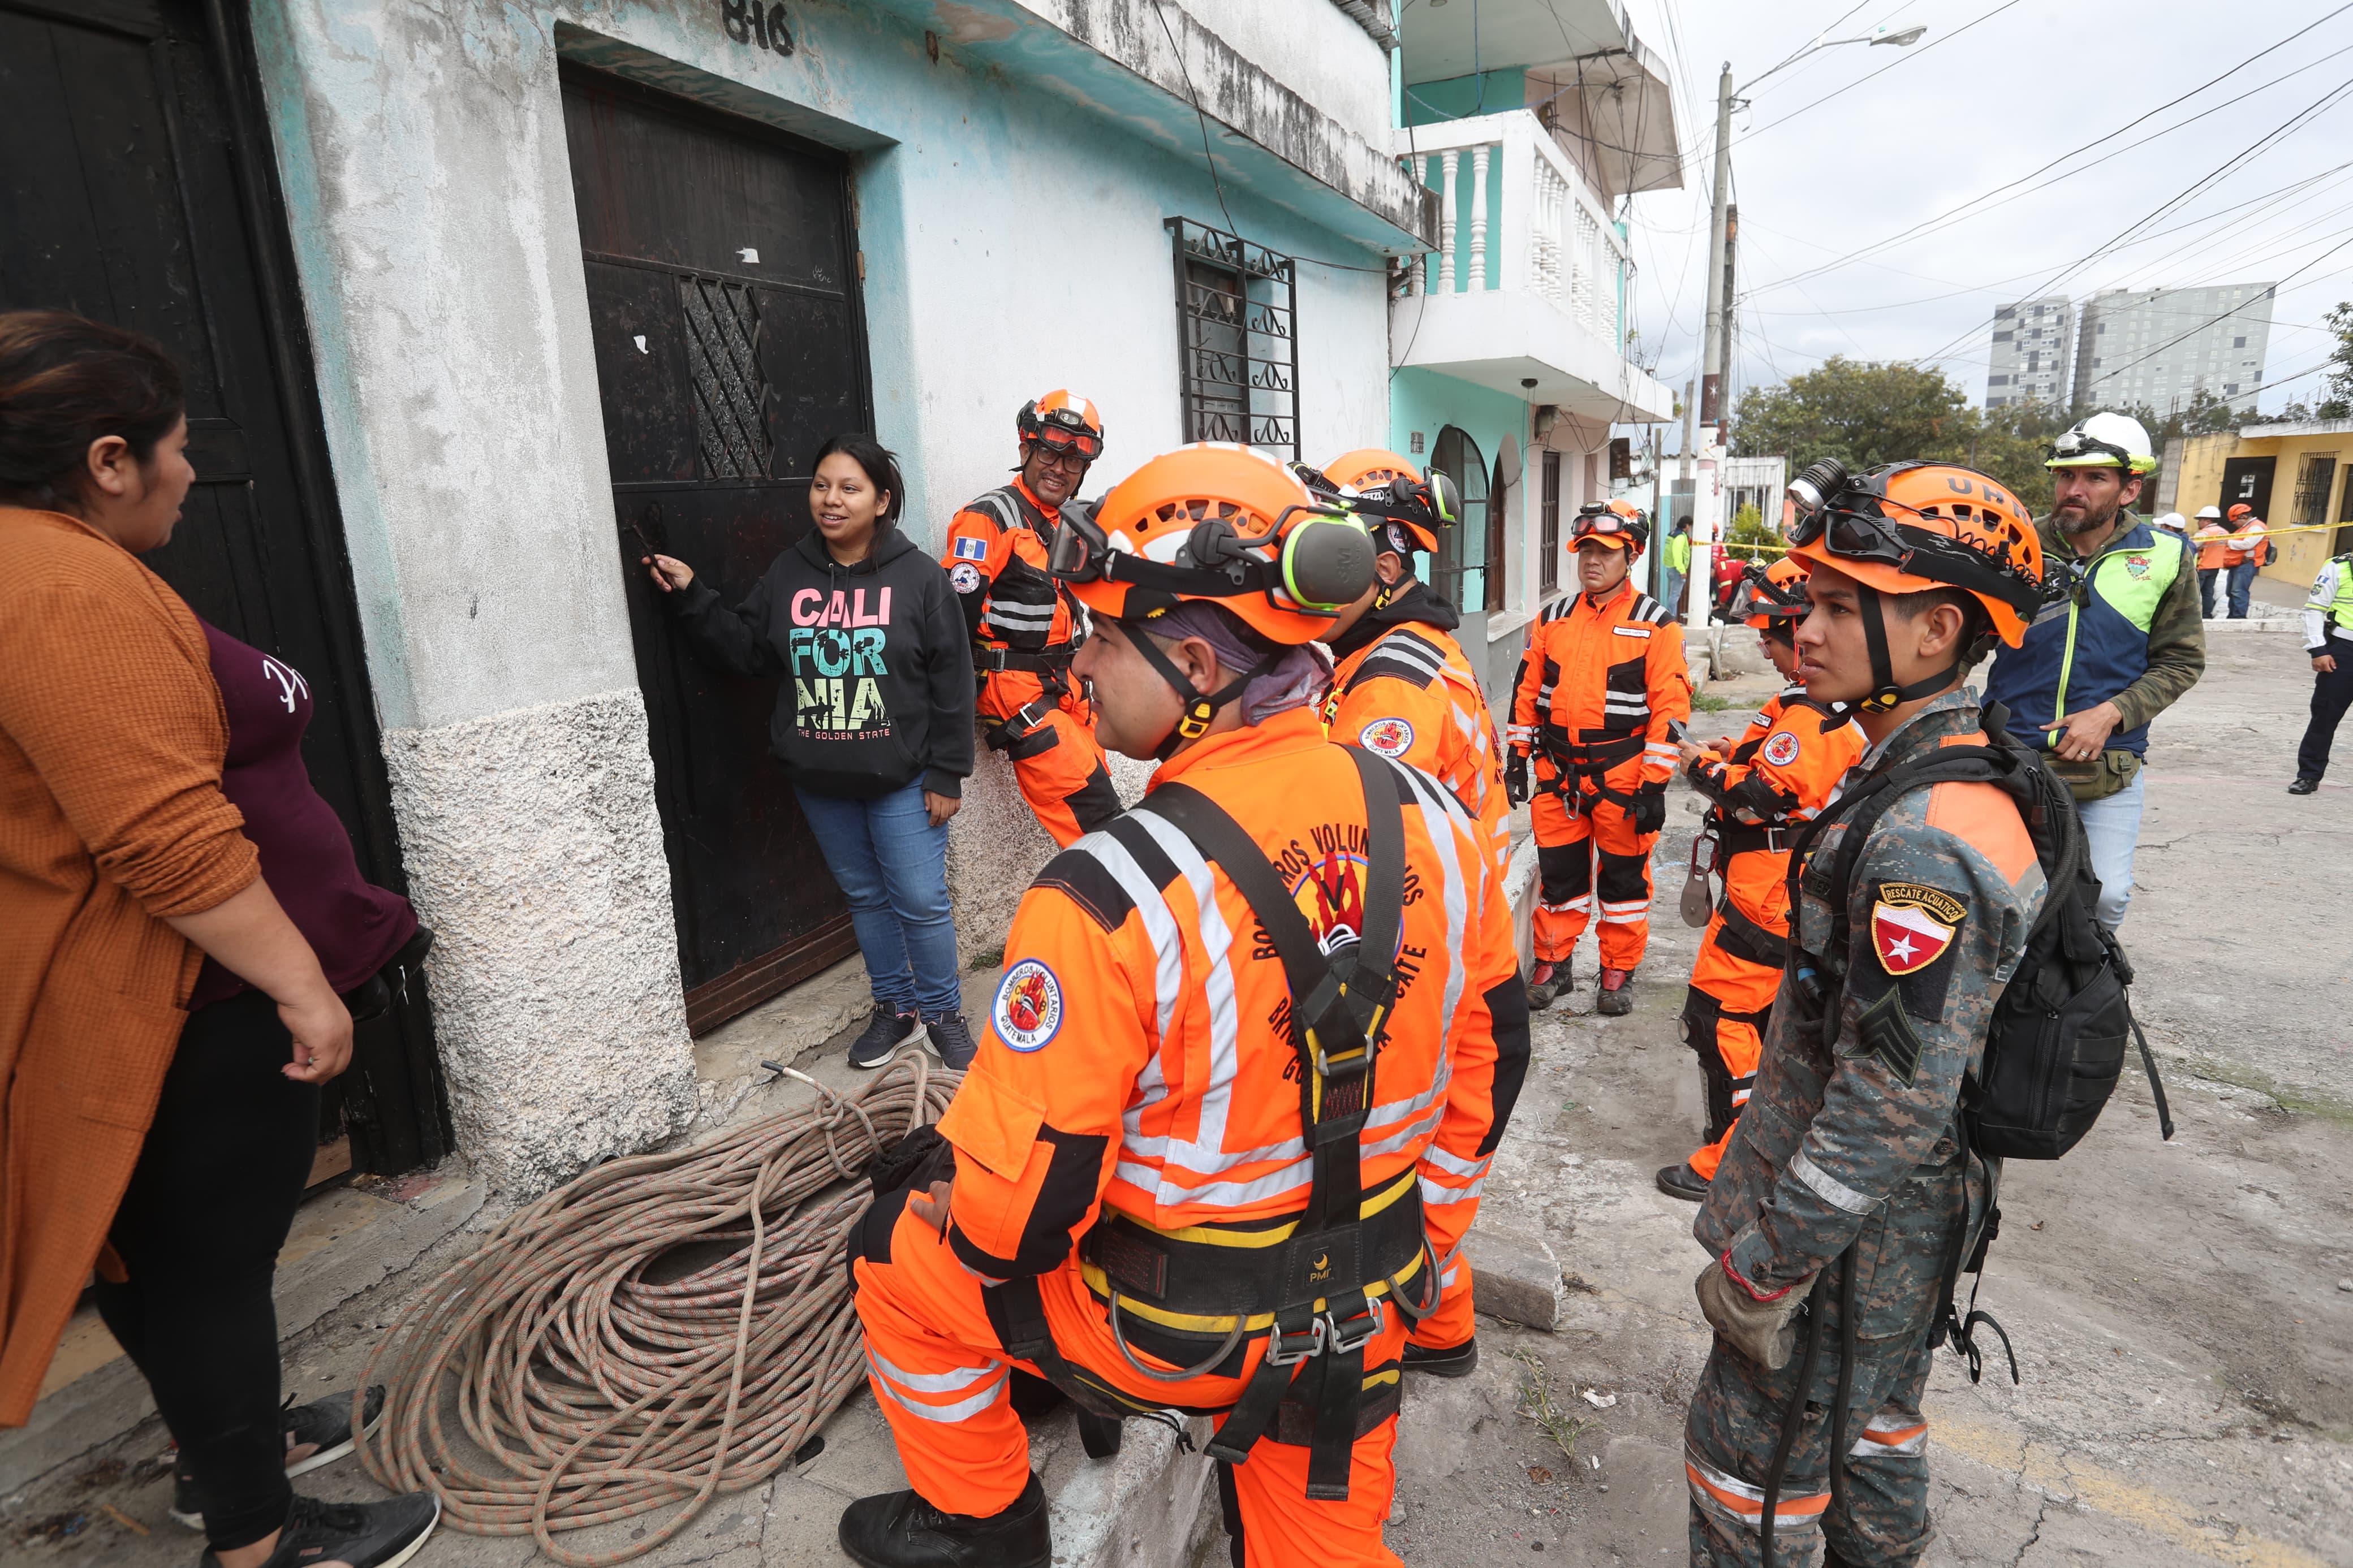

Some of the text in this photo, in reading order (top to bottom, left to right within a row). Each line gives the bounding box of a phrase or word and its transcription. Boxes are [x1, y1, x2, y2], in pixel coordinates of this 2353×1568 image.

[791, 586, 891, 628] CALI
[1779, 606, 1801, 615] 3M
[789, 628, 889, 677] FOR
[795, 677, 891, 730] NIA
[798, 728, 890, 740] THE GOLDEN STATE
[1365, 722, 1386, 739] BOMBEROS
[1369, 745, 1399, 754] GUATEMALA
[1886, 888, 1959, 918] RESCATE ACUATICO
[1002, 966, 1058, 1029] BOMBEROS VOLUNTARIOS
[1015, 985, 1046, 1011] C B
[1001, 1016, 1036, 1044] GUATEMALA
[1310, 1269, 1330, 1282] PMI
